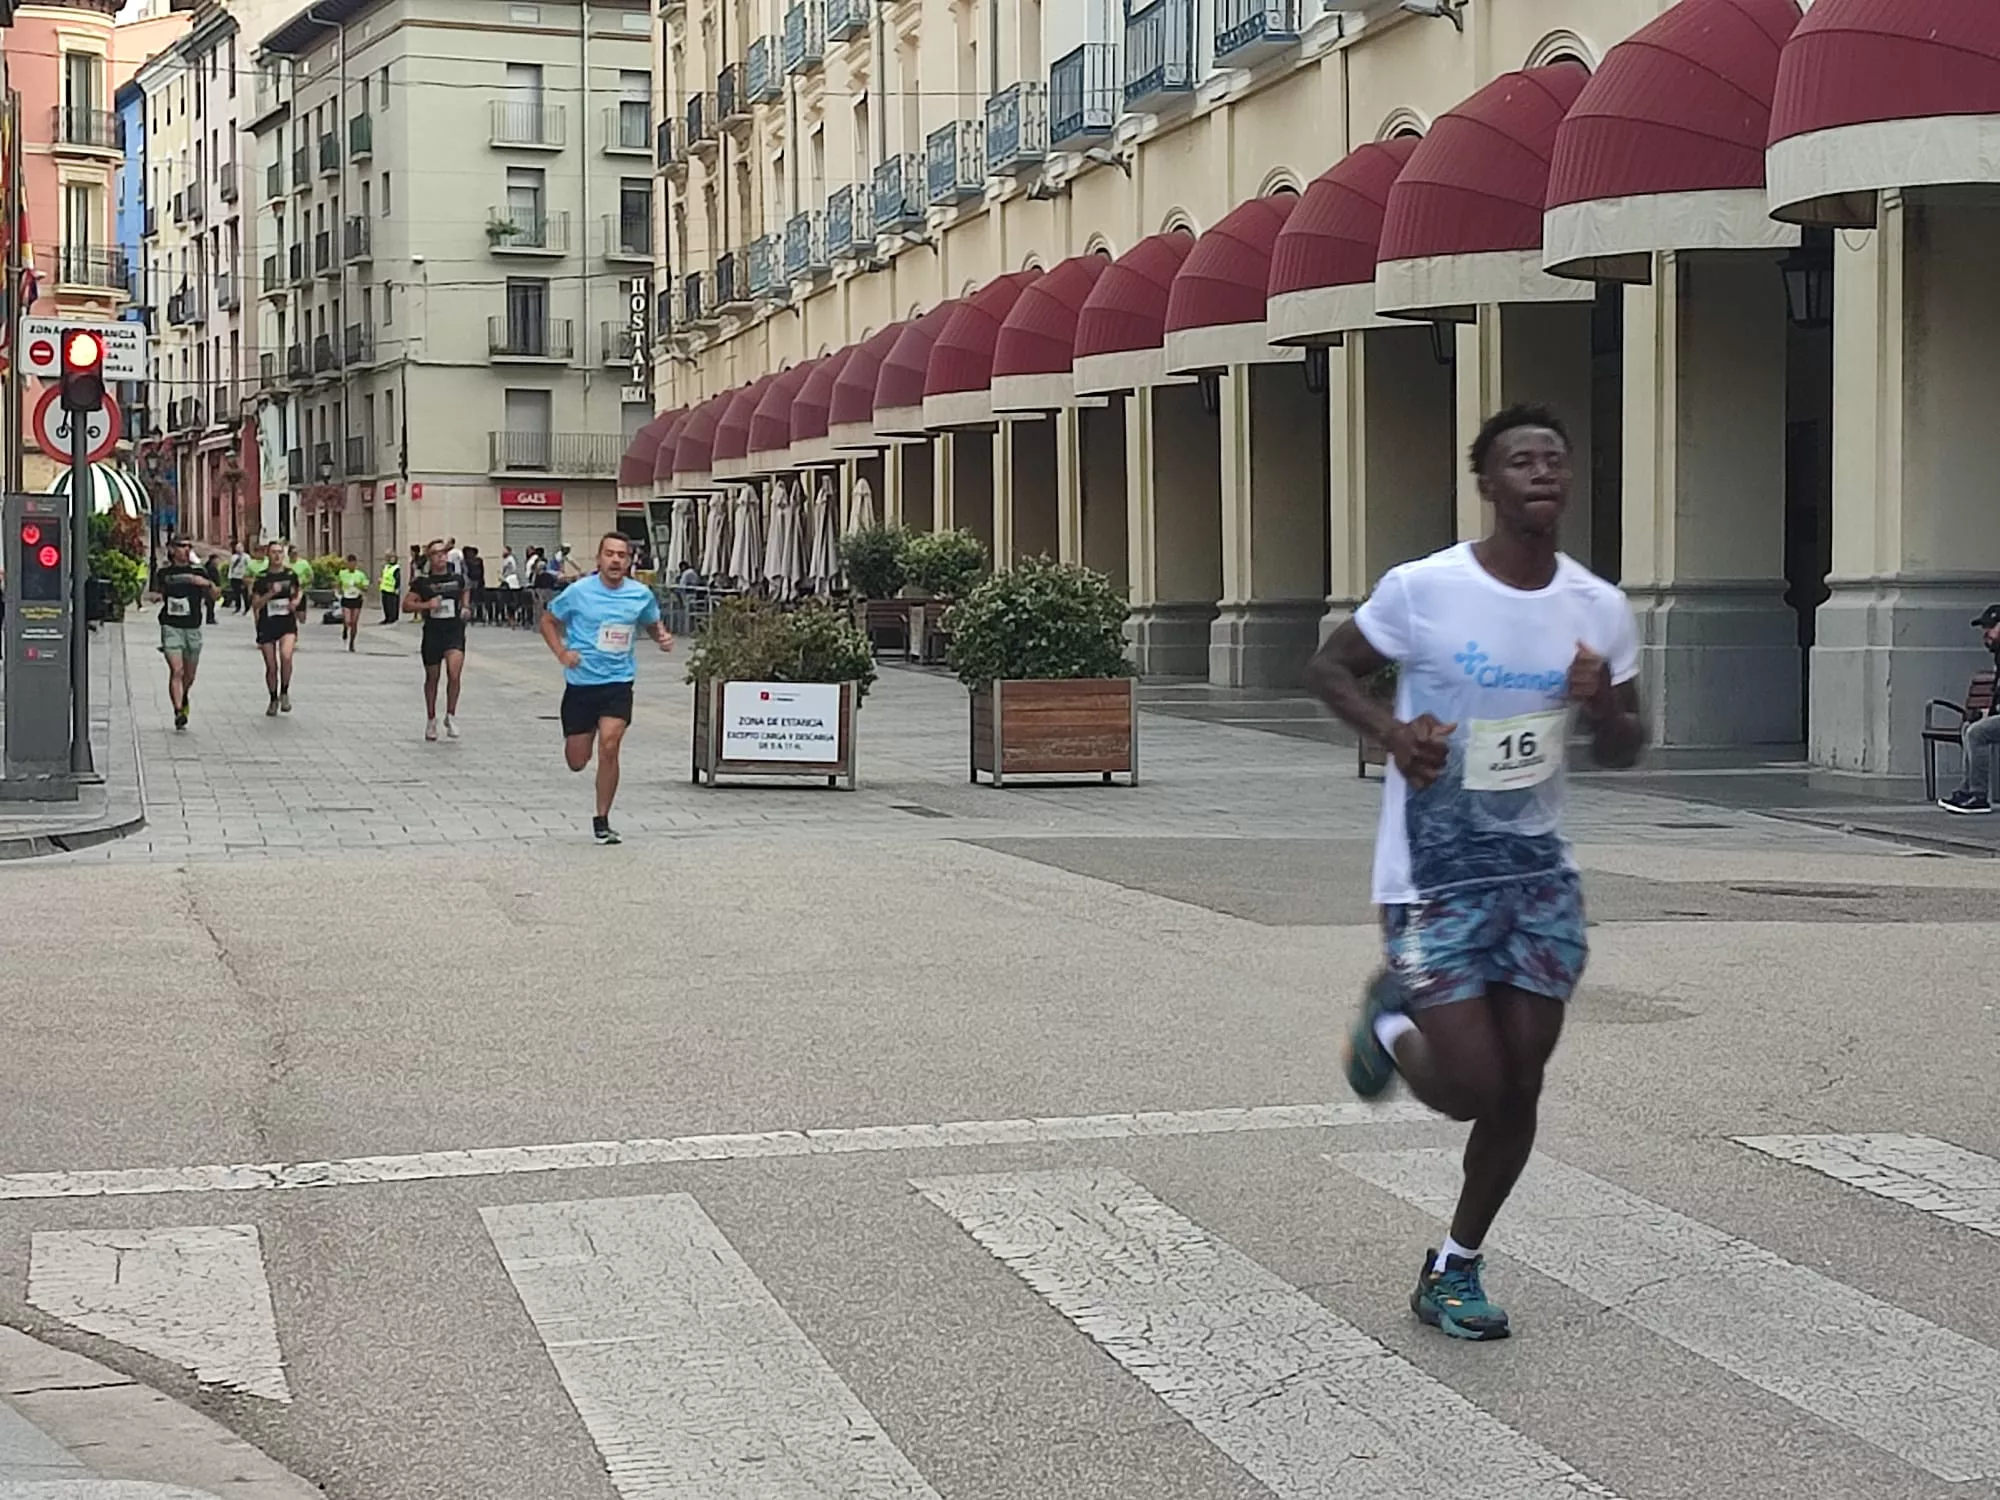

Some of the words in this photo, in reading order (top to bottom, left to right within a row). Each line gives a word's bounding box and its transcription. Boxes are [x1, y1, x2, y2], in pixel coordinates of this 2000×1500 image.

[29, 324, 60, 334] ZONA
[631, 277, 646, 382] HOSTAL
[517, 492, 546, 504] GAES
[738, 716, 765, 726] ZONA
[767, 717, 779, 726] DE
[781, 718, 824, 728] ESTANCIA
[727, 731, 759, 740] EXCEPTO
[761, 732, 787, 740] CARGA
[795, 733, 835, 742] DESCARGA
[1498, 731, 1537, 760] 16
